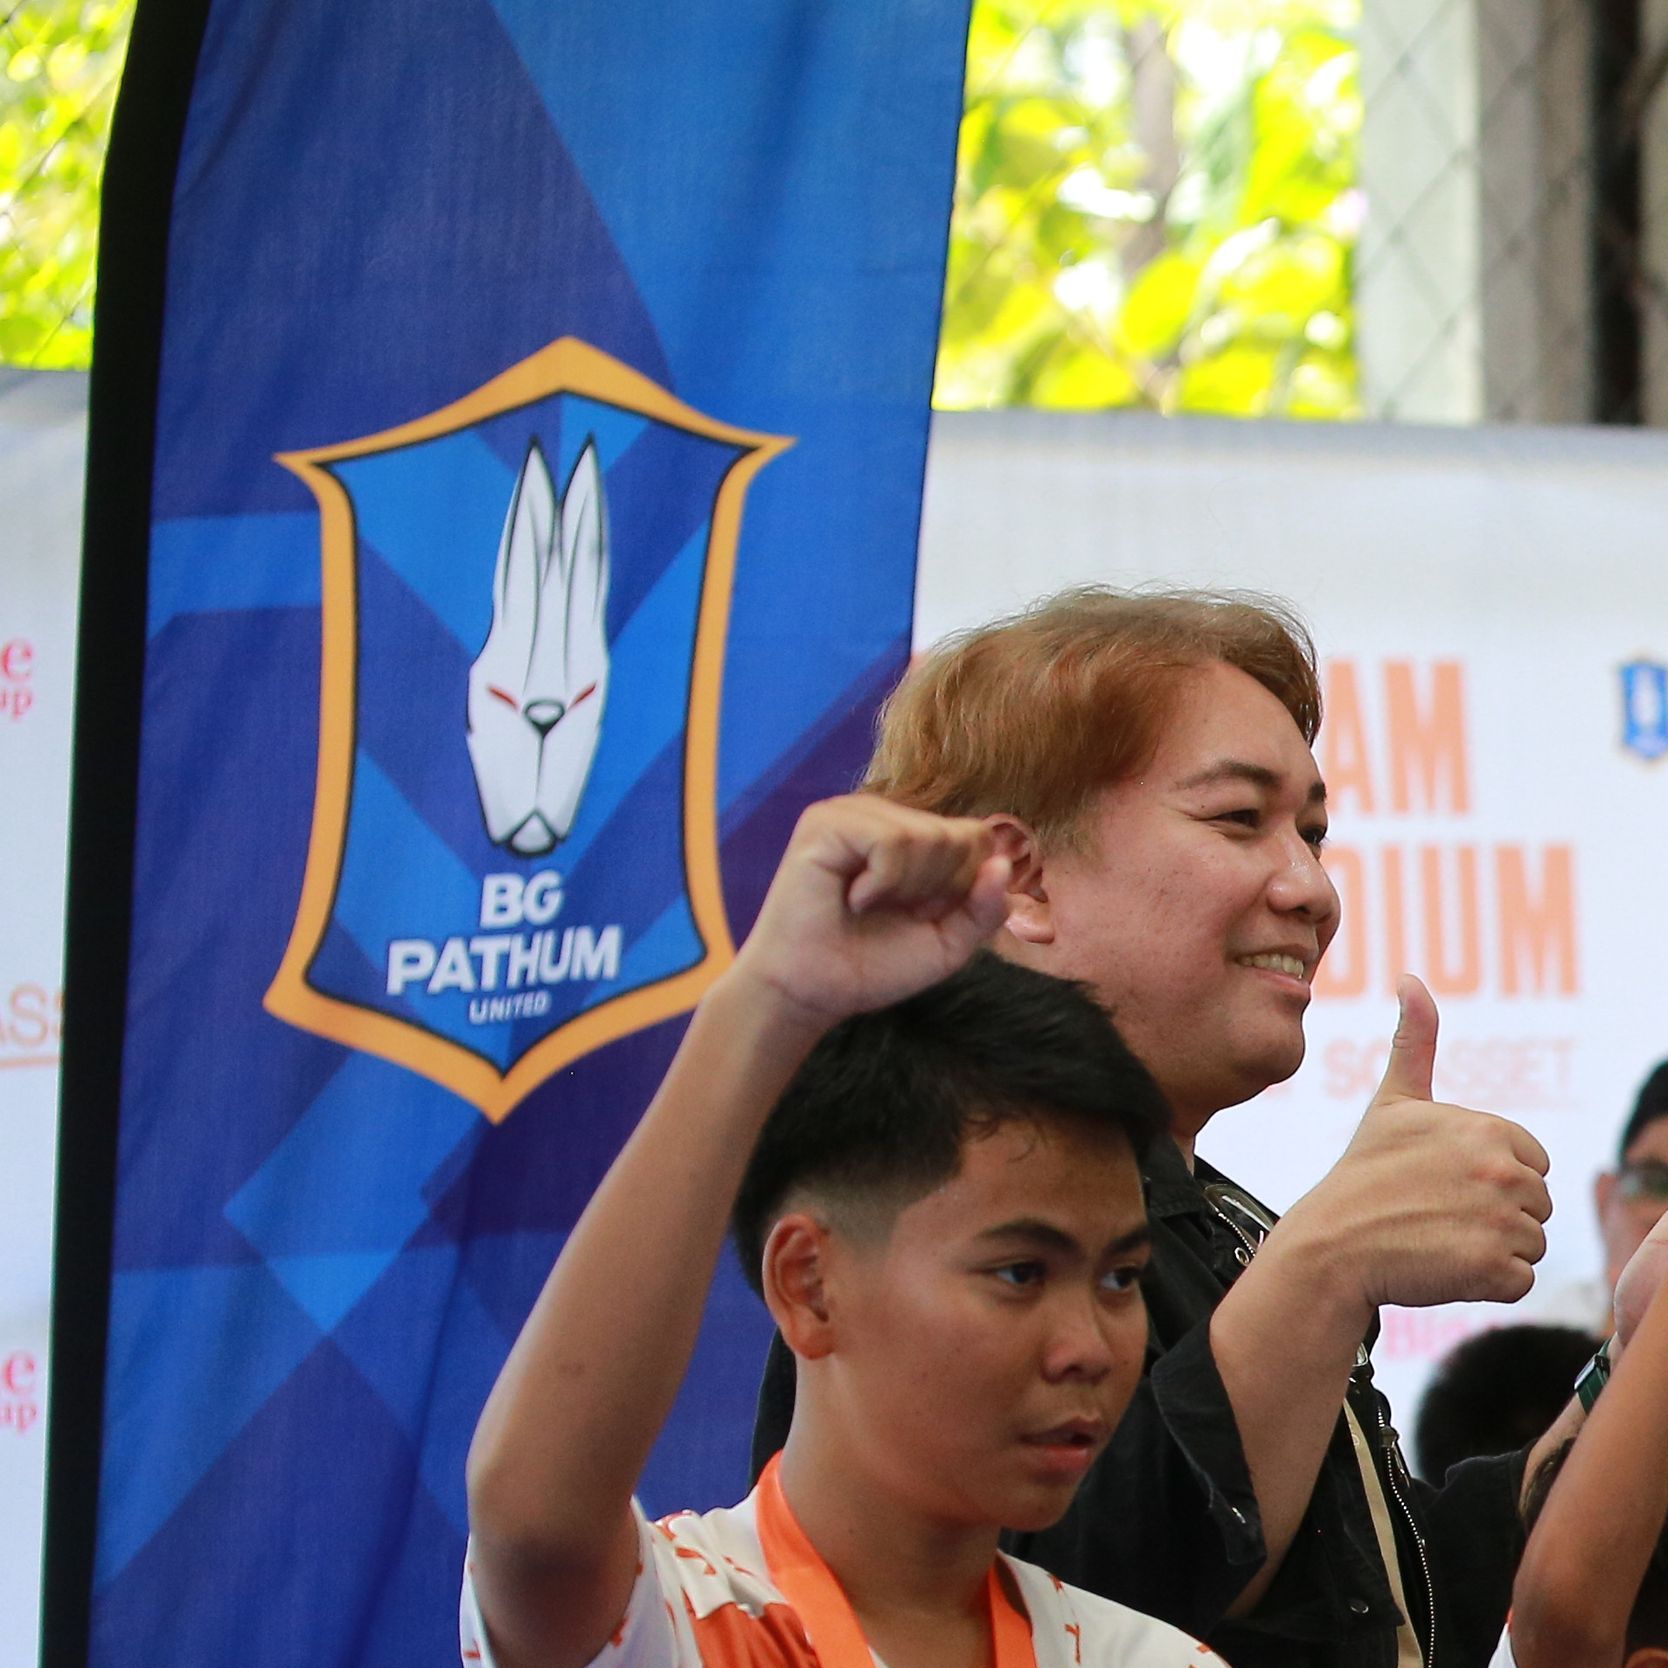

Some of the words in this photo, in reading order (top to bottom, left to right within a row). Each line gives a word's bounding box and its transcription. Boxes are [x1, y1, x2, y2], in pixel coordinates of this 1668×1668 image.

[479, 868, 565, 930] BG
[1308, 843, 1578, 1000] DIUM
[385, 923, 624, 996] PATHUM
[468, 990, 551, 1026] UNITED
